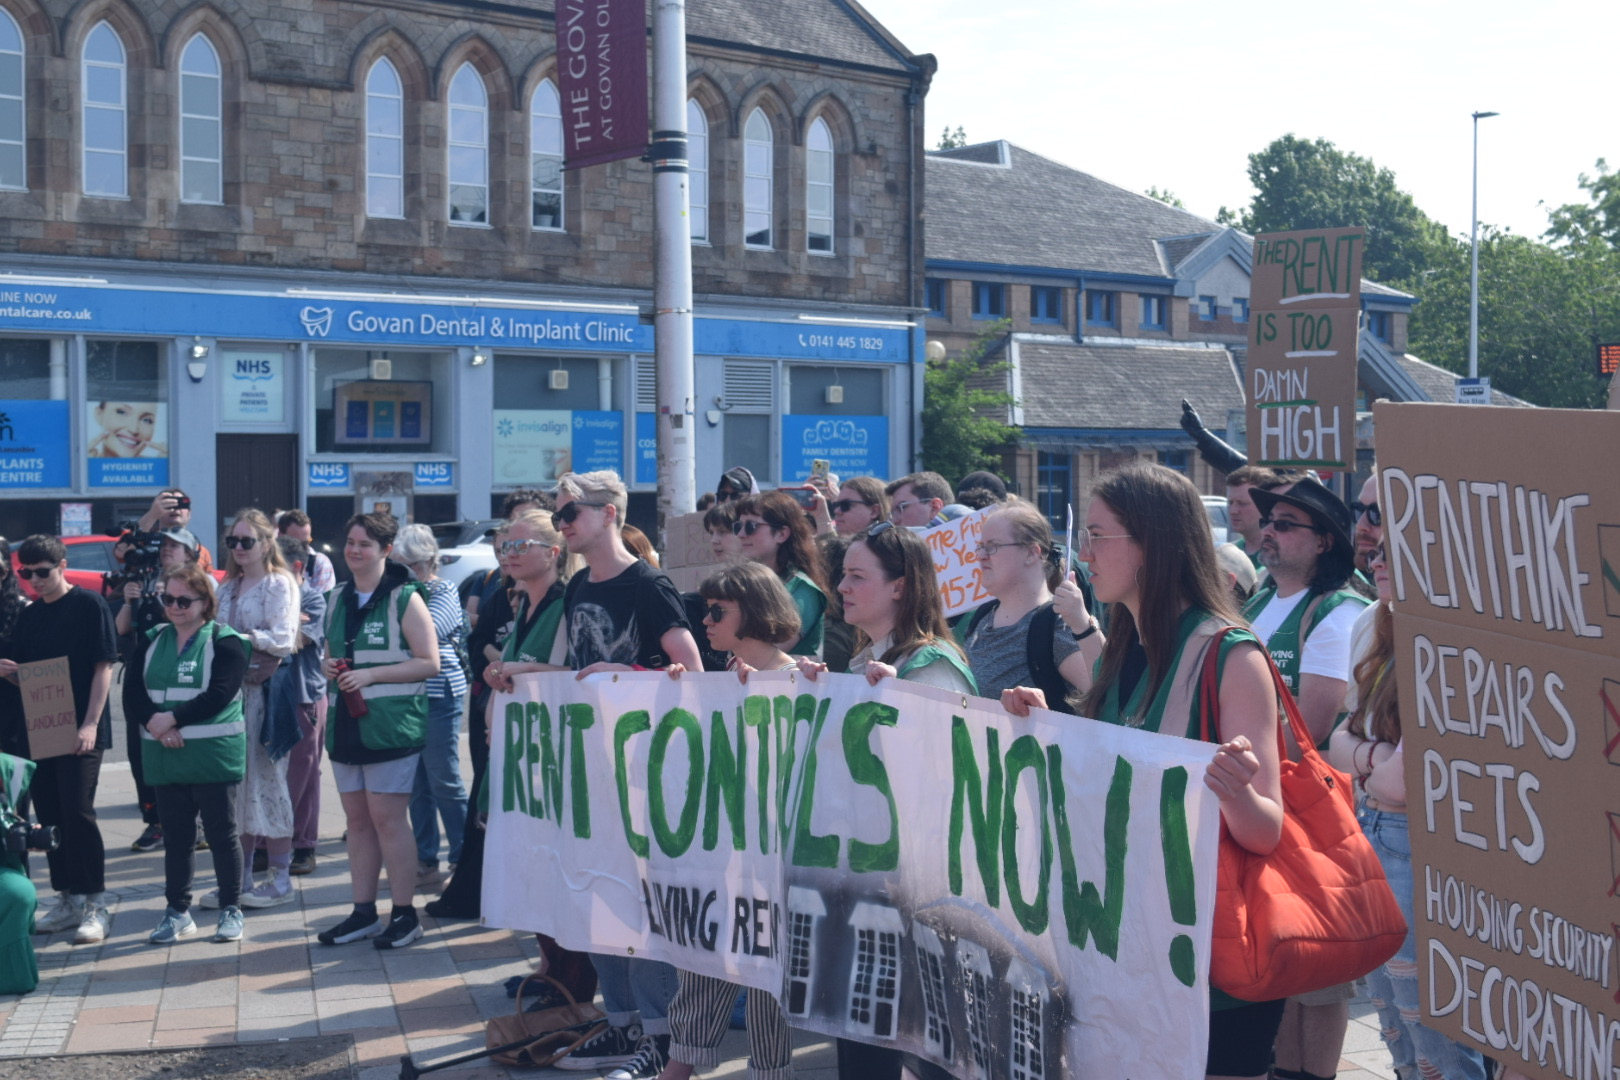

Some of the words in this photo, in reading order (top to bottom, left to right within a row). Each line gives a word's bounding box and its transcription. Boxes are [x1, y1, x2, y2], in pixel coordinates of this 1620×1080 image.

[567, 0, 587, 79] GOV
[598, 33, 612, 110] GOVAN
[571, 88, 592, 150] THE
[602, 117, 613, 140] AT
[1257, 239, 1284, 266] THE
[1282, 234, 1362, 297] RENT
[0, 292, 20, 303] INE
[24, 293, 57, 304] NOW
[348, 310, 414, 334] Govan
[420, 313, 485, 337] Dental
[490, 317, 504, 338] &
[509, 318, 581, 344] Implant
[585, 320, 634, 343] Clinic
[1256, 312, 1277, 346] IS
[1286, 312, 1332, 351] TOO
[809, 335, 834, 347] 0141
[837, 336, 856, 349] 445
[860, 338, 883, 350] 1829
[236, 360, 271, 374] NHS
[1254, 366, 1308, 401] DAMN
[517, 420, 568, 435] invisalign
[1260, 405, 1341, 461] HIGH
[802, 447, 828, 456] FAMILY
[830, 447, 869, 456] DENTISTRY
[0, 471, 42, 483] ENTRE
[102, 463, 154, 471] HYGIENIST
[102, 475, 154, 483] AVAILABLE
[312, 464, 344, 476] NHS
[417, 463, 447, 475] NHS
[1270, 650, 1294, 659] IVING
[20, 661, 66, 682] DOWN
[29, 683, 65, 702] WITH
[1413, 633, 1577, 759] REPAIRS
[503, 701, 594, 839] RENT
[614, 693, 899, 873] CONTROLS
[1423, 749, 1545, 865] PETS
[642, 879, 717, 952] LIVING
[731, 896, 782, 961] REN
[1425, 864, 1523, 955] HOUSING
[1527, 906, 1613, 989] SECURITY
[1428, 938, 1620, 1080] DECORATING
